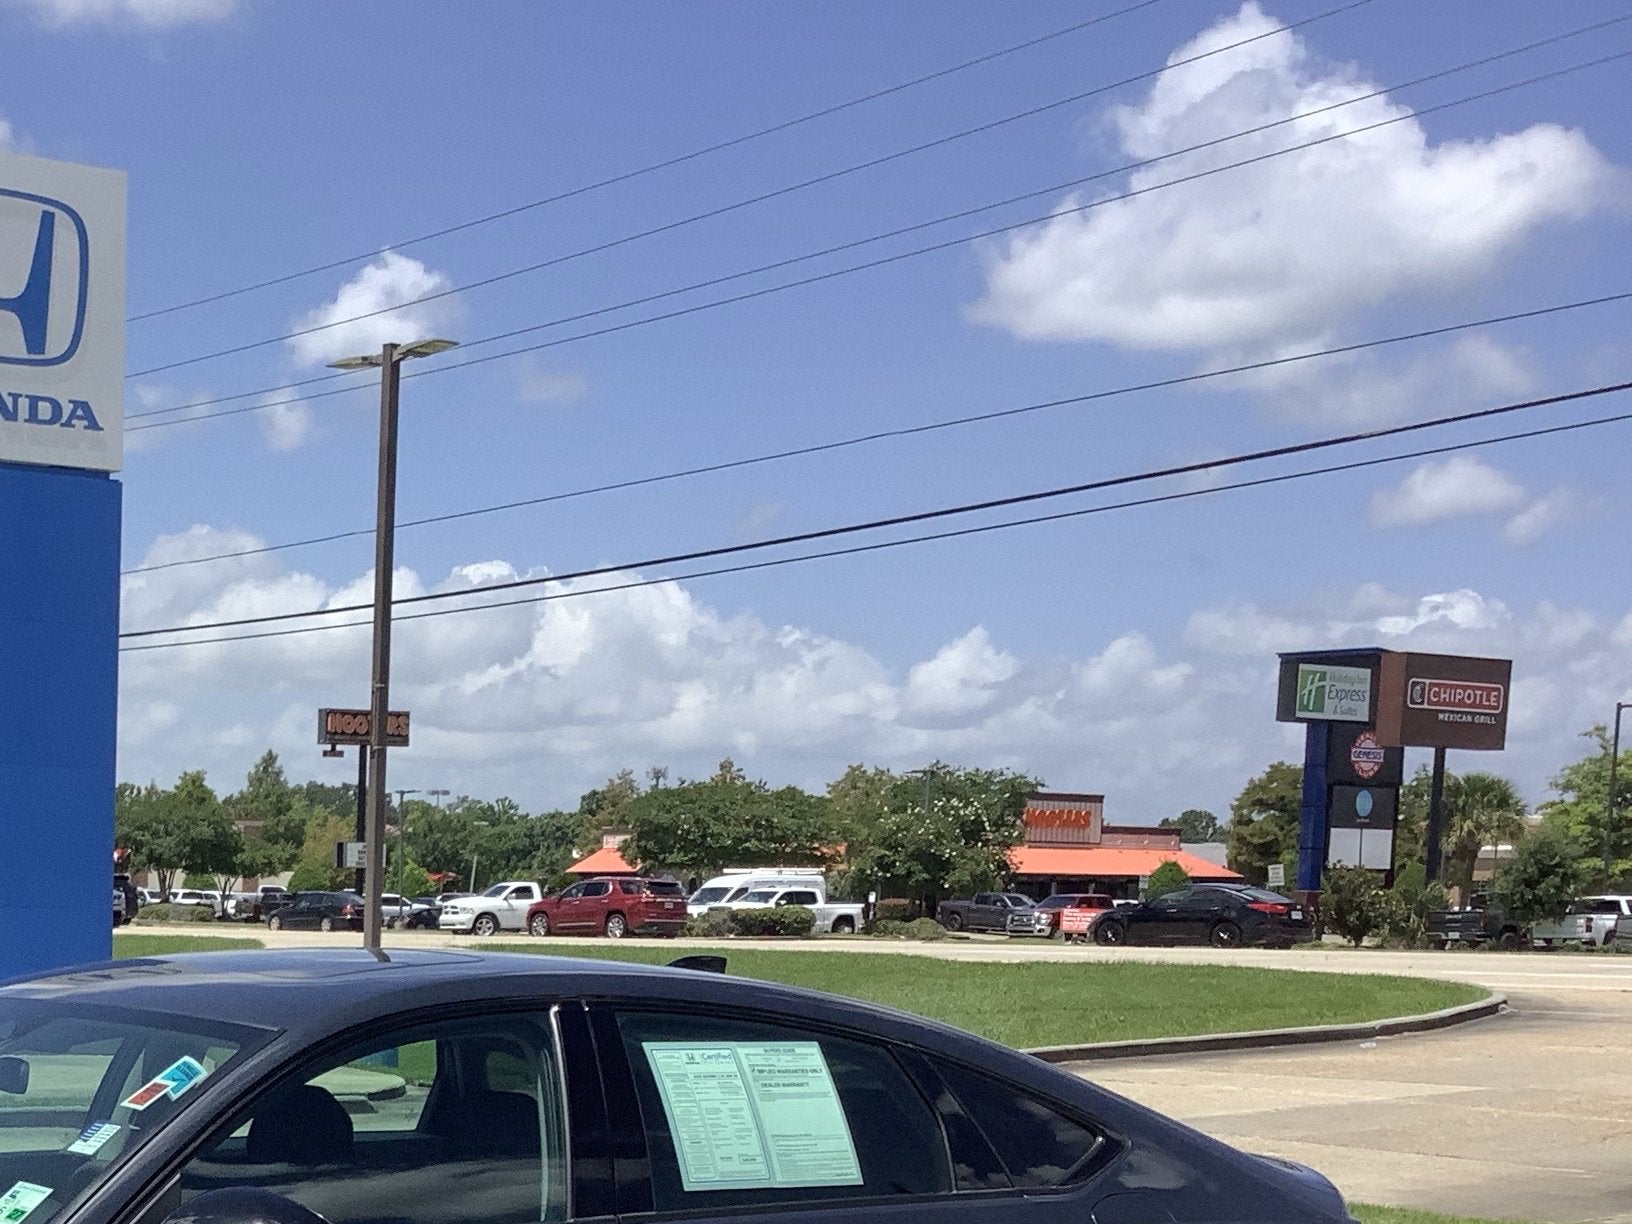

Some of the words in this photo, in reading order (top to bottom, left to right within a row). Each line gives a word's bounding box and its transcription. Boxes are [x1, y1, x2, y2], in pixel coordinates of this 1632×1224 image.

[1327, 685, 1367, 702] Express
[1429, 687, 1498, 706] CHIPOTLE
[328, 713, 409, 735] HOORS
[1438, 713, 1472, 724] MEXICAN
[1474, 714, 1496, 724] GRILL
[701, 1052, 732, 1061] Certified
